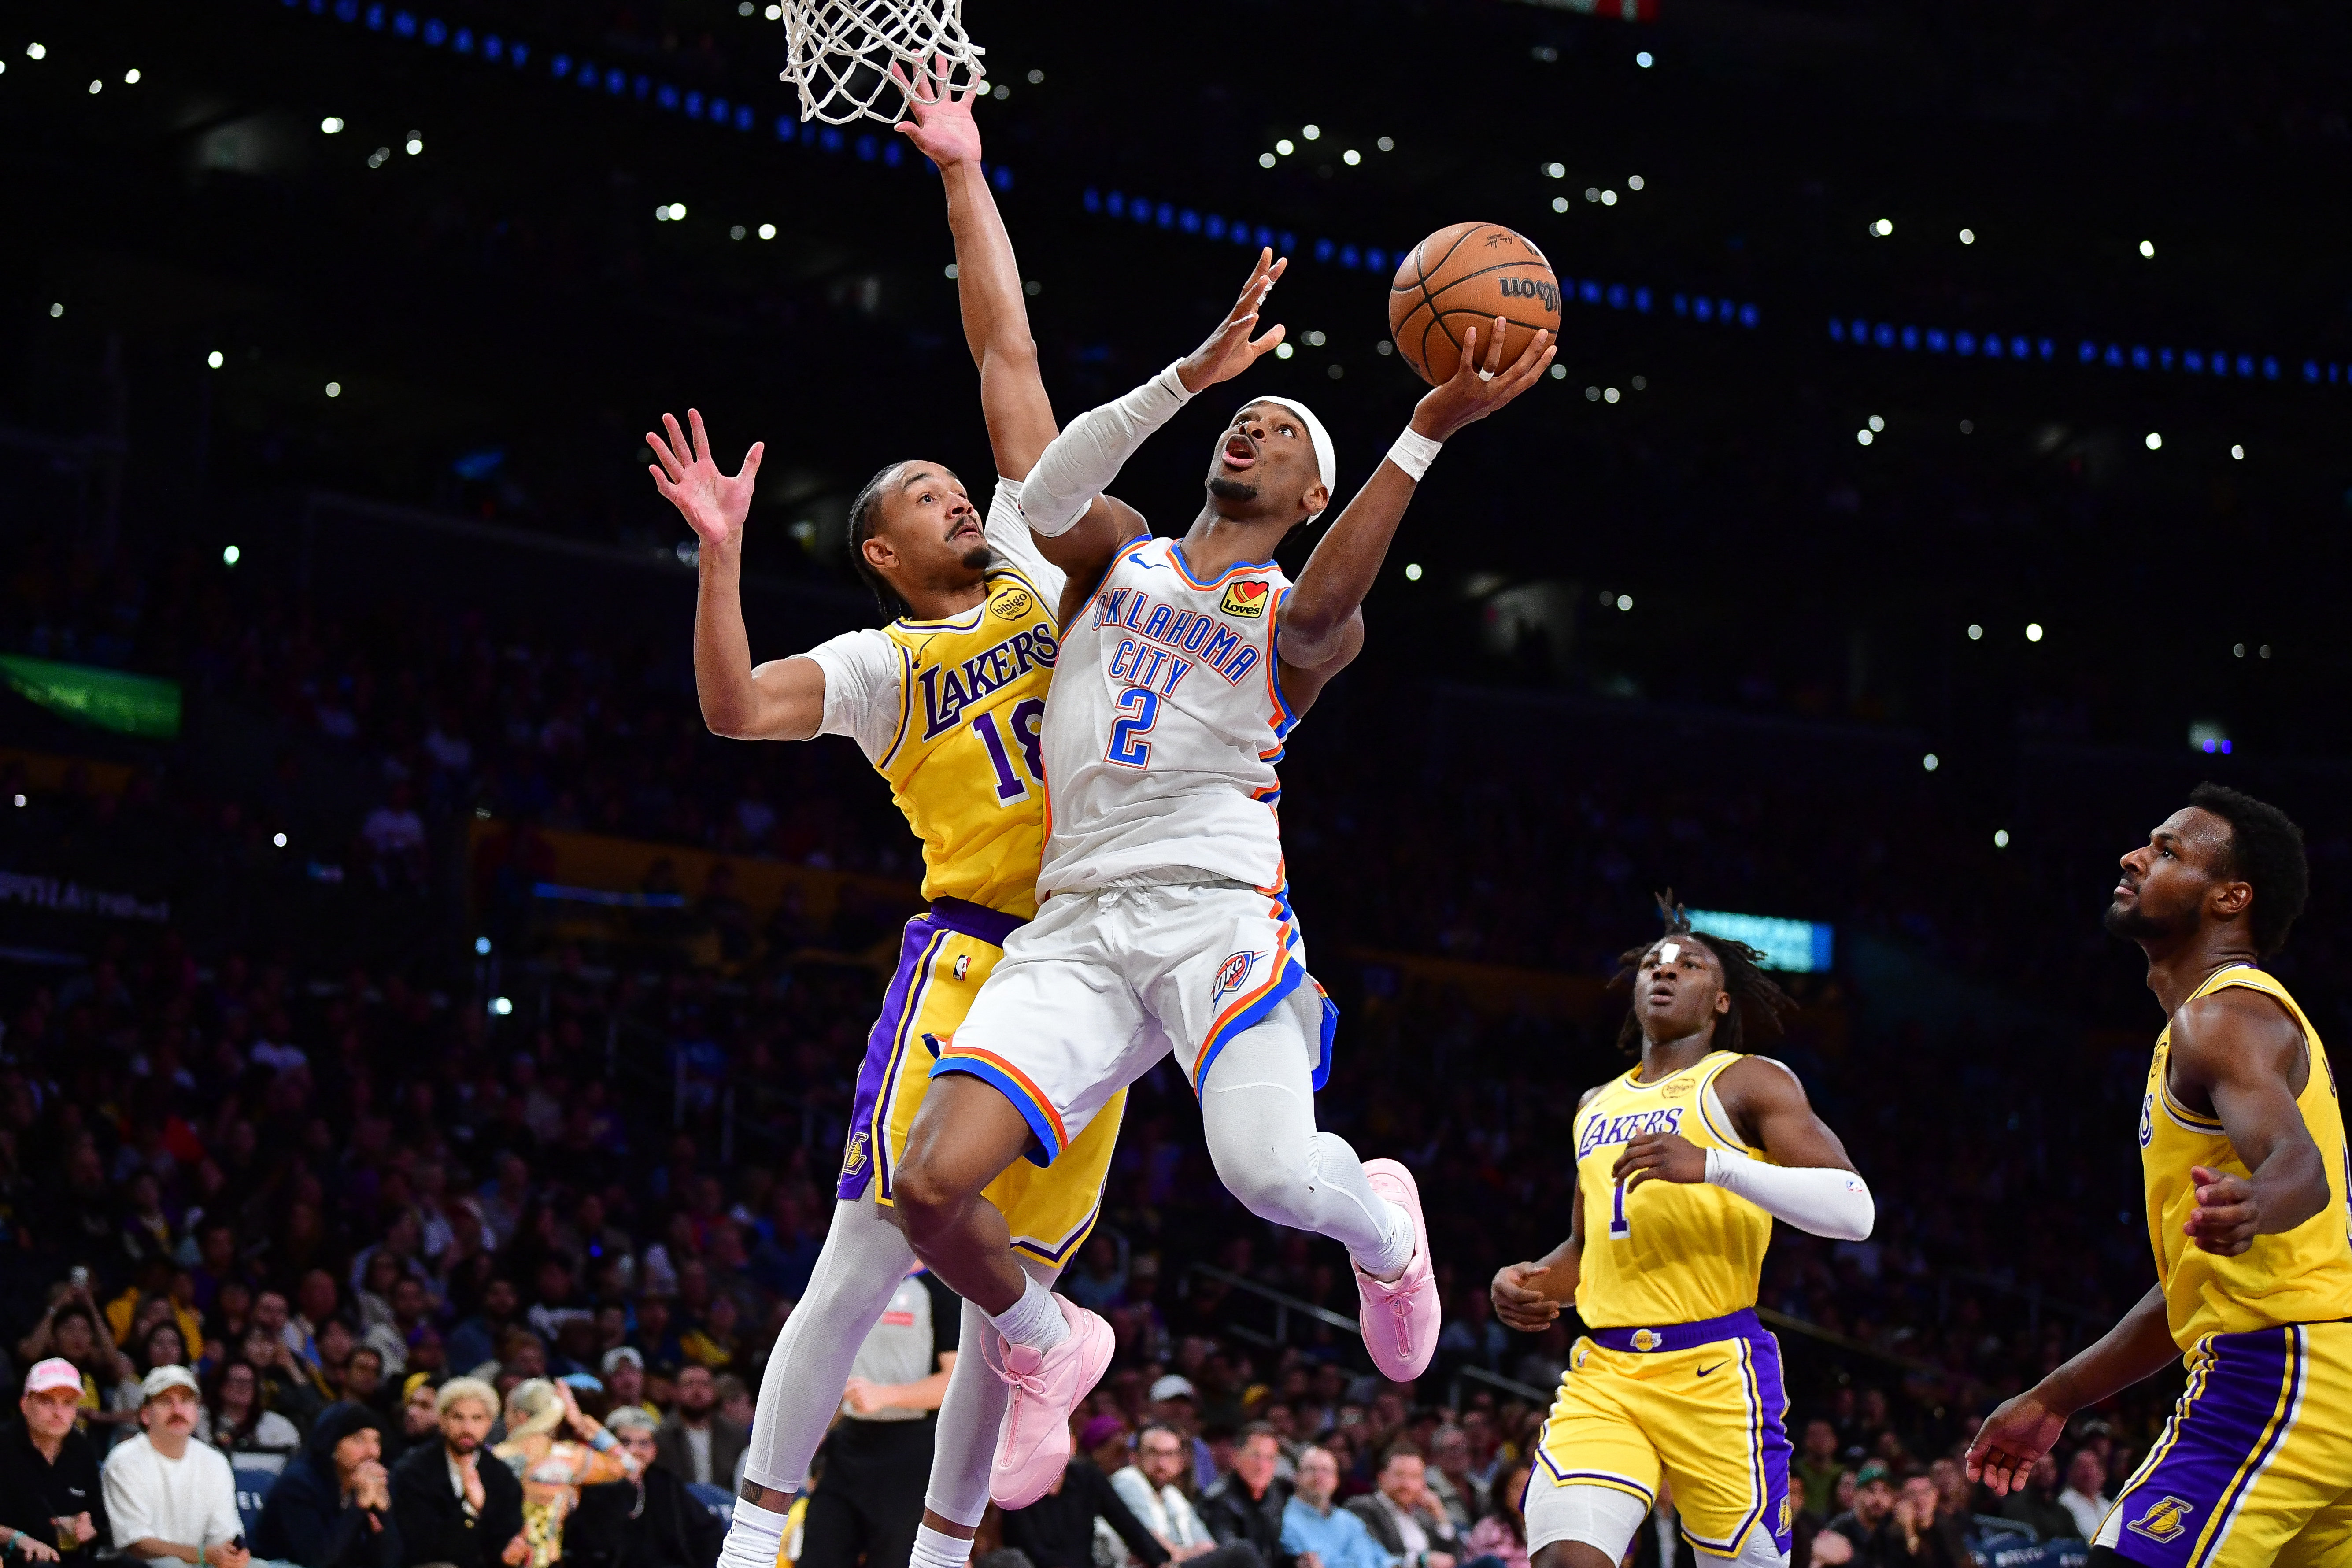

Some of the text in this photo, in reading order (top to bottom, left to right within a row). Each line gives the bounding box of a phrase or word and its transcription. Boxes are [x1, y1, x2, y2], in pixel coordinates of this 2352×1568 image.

[994, 591, 1027, 615] bibigo
[1092, 588, 1261, 688] OKLAHOMA
[1109, 638, 1194, 698] CITY
[918, 624, 1058, 742] LAKERS
[1104, 684, 1161, 770] 2
[1213, 958, 1243, 1003] OKC
[1578, 1108, 1683, 1161] LAKERS
